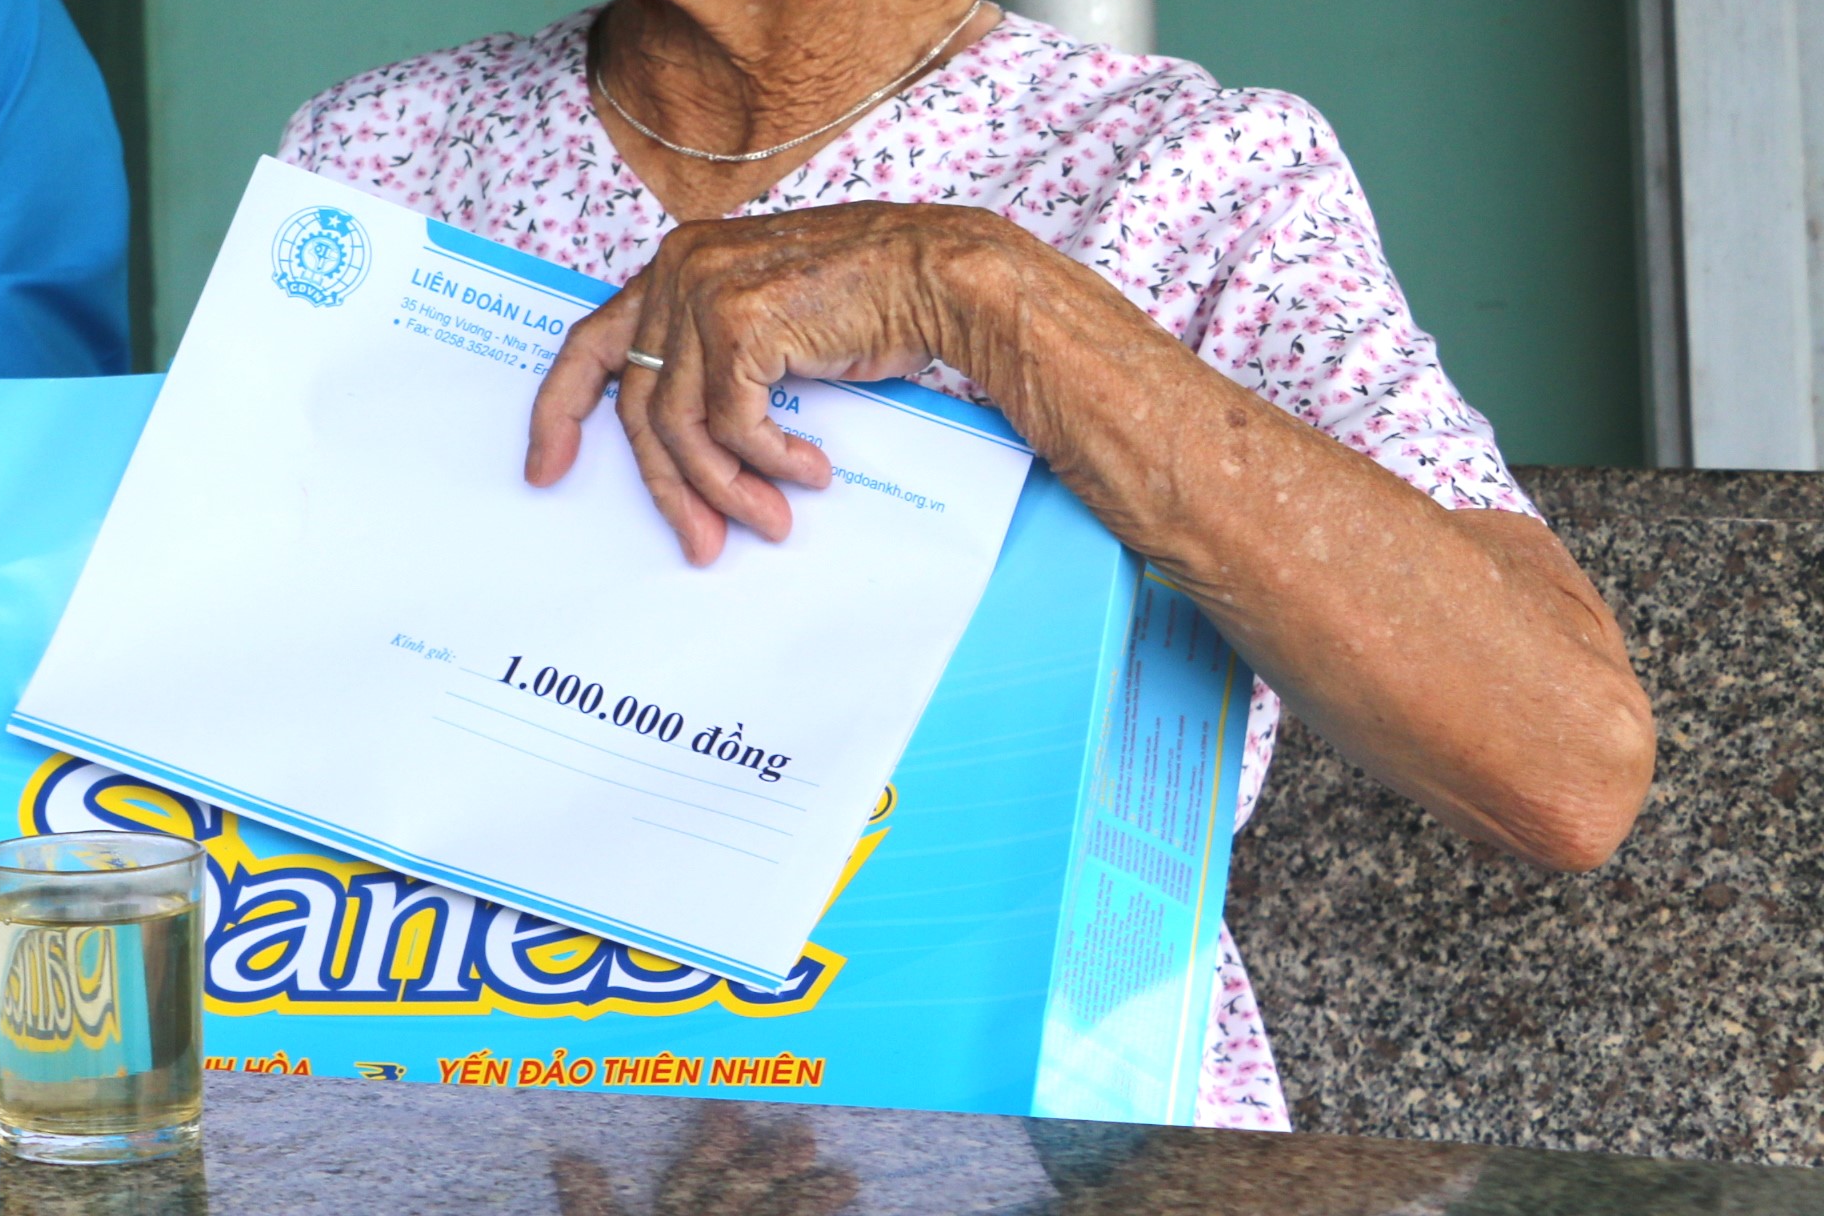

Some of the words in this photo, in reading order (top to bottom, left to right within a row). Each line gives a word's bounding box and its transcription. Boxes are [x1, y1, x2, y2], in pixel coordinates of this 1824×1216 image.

[411, 268, 458, 298] LIÊN
[462, 287, 520, 321] ĐOÀN
[522, 309, 565, 335] LAO
[400, 296, 417, 312] 35
[419, 303, 452, 327] Hùng
[455, 315, 493, 342] Vương
[503, 334, 527, 352] Nha
[530, 343, 559, 361] Tran
[406, 317, 431, 337] Fax:
[434, 328, 519, 366] 0258.3524012
[769, 384, 801, 414] ÒA
[831, 465, 946, 513] ongdoankh.org.vn
[390, 633, 425, 653] Kính
[497, 654, 685, 743] 1.000.000
[691, 722, 792, 783] đồng
[438, 1048, 511, 1085] YẾN
[518, 1047, 595, 1086] ĐẢO
[603, 1051, 701, 1085] THIÊN
[708, 1051, 825, 1086] NHIÊN
